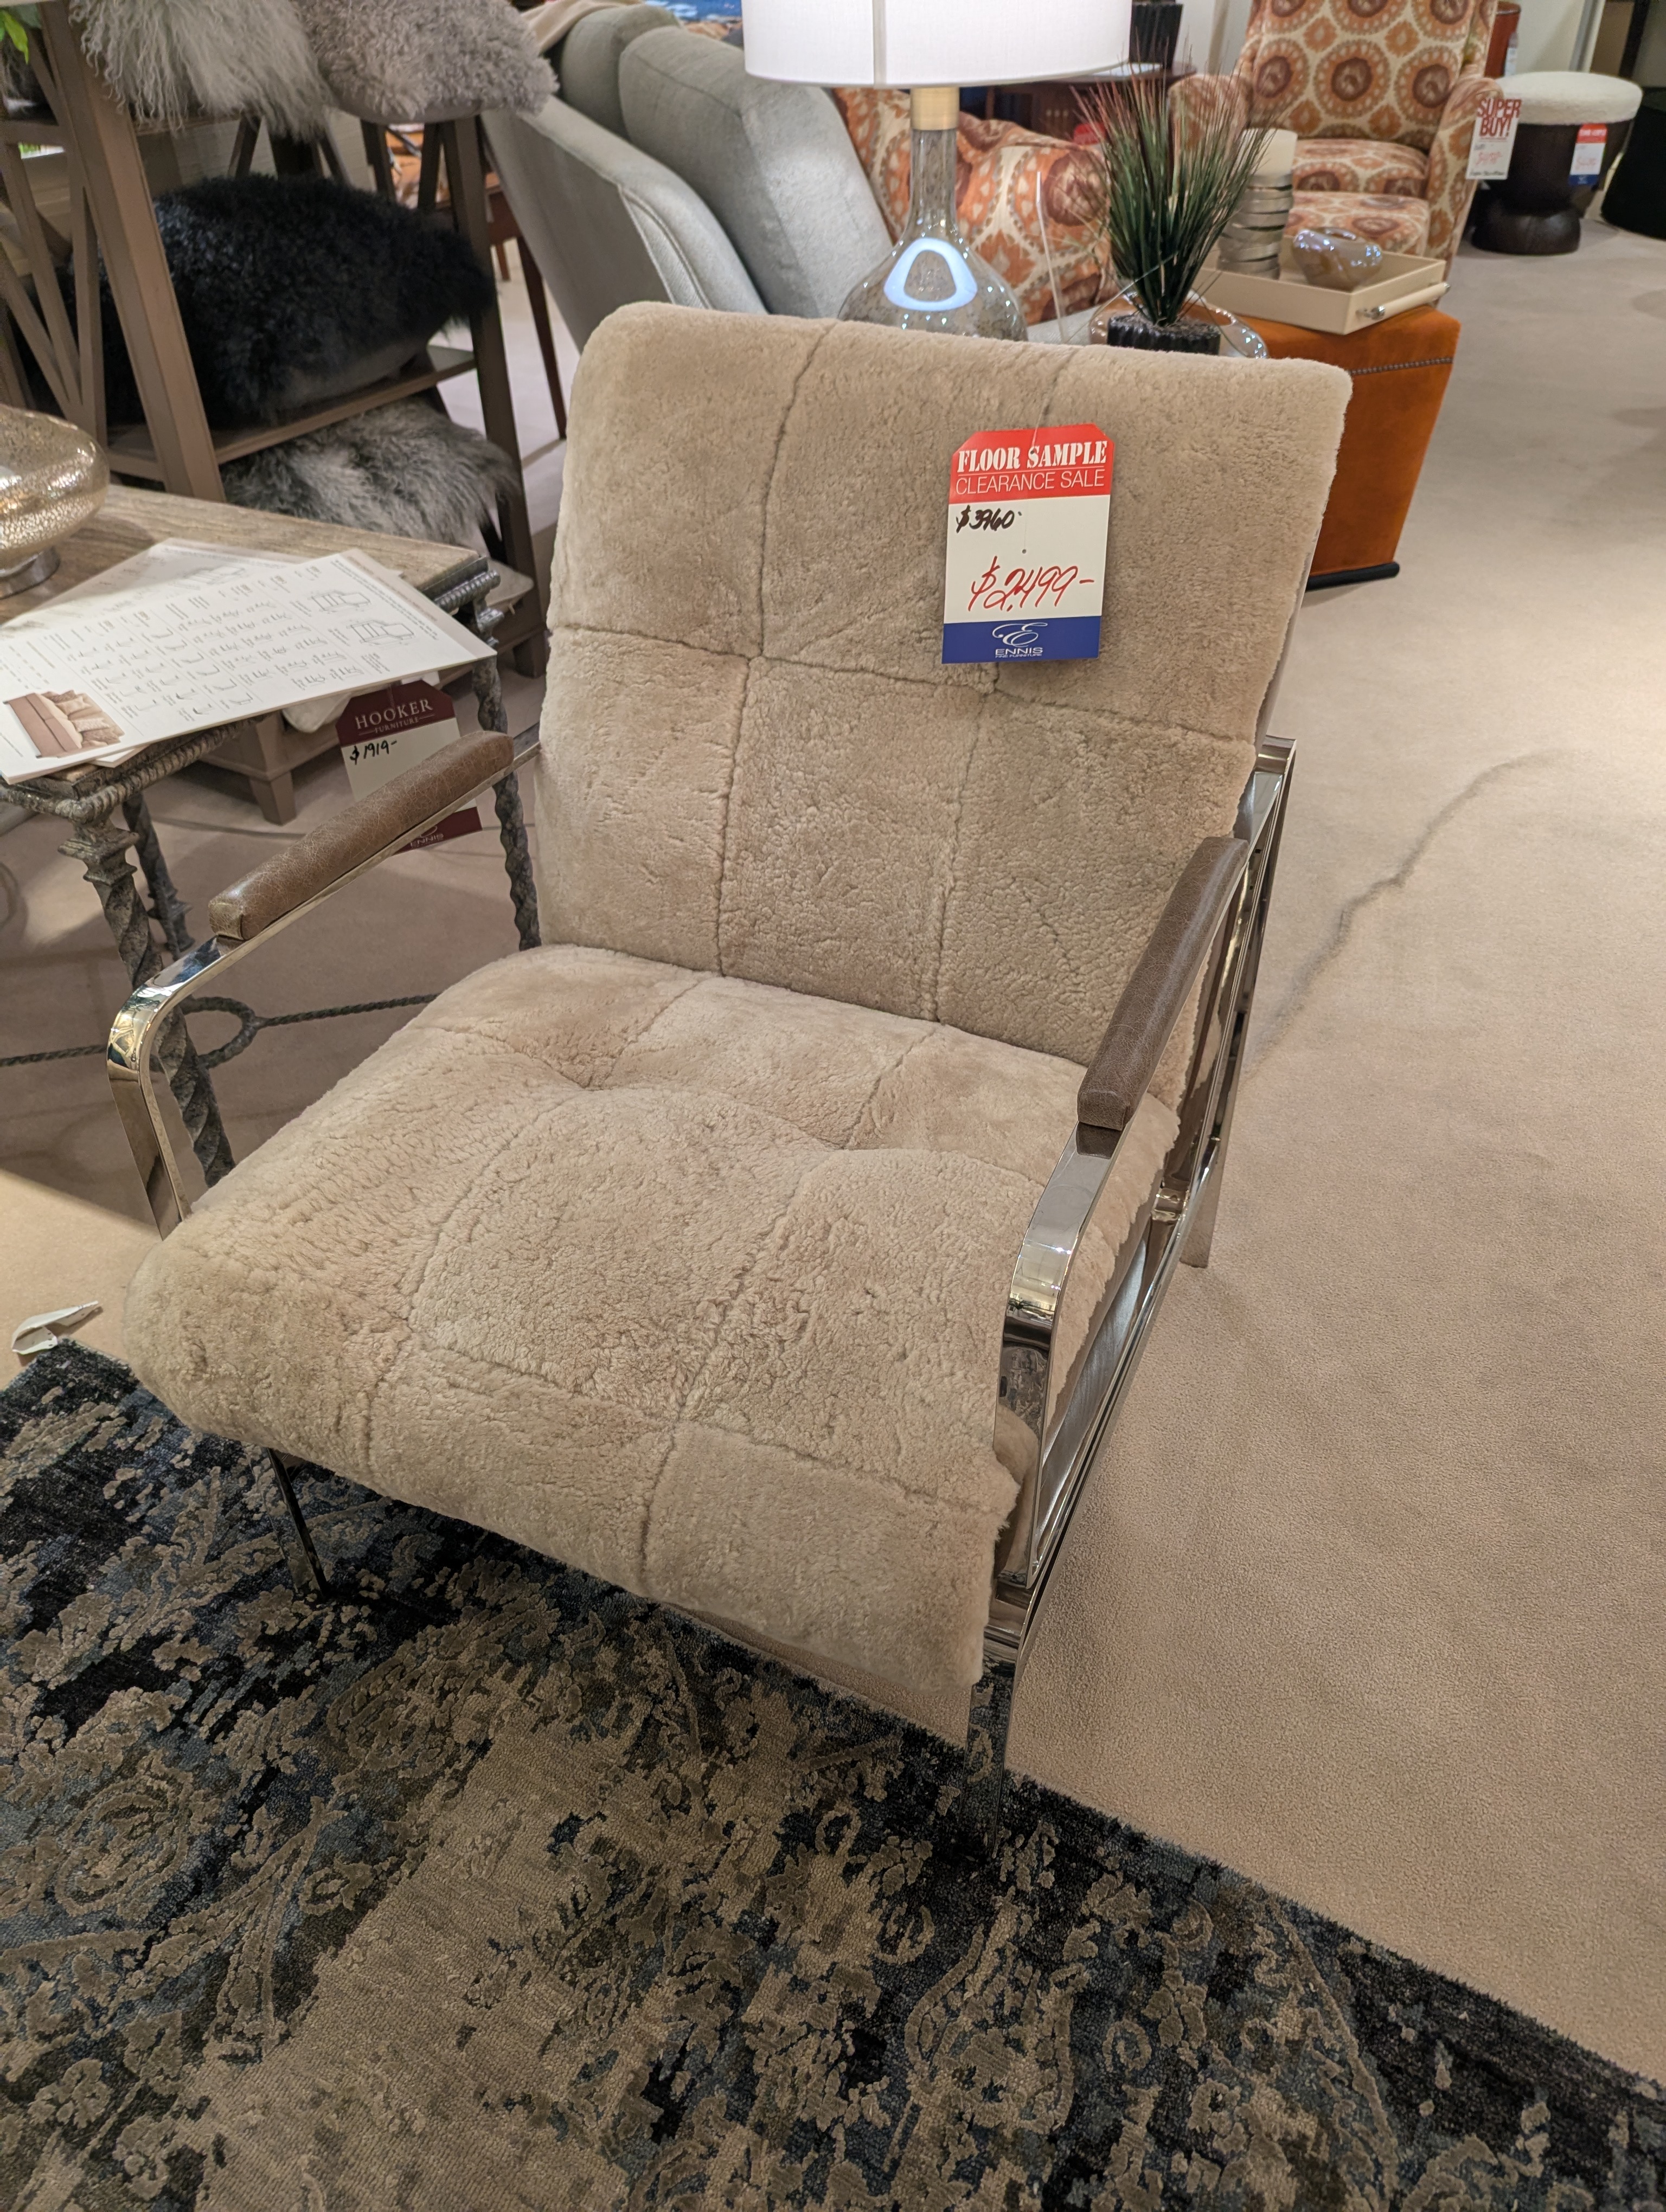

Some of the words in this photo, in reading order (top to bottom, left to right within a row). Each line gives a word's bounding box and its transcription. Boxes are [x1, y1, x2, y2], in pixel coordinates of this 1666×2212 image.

[1477, 98, 1522, 119] SUPER
[1479, 118, 1511, 137] BUY!
[957, 447, 1021, 473] FLOOR
[1027, 440, 1108, 468] SAMPLE
[956, 472, 1056, 496] CLEARANCE
[1060, 468, 1105, 488] SALE
[995, 647, 1044, 655] ENNIS
[355, 699, 434, 730] HOOKER
[375, 716, 420, 734] FURNITURE
